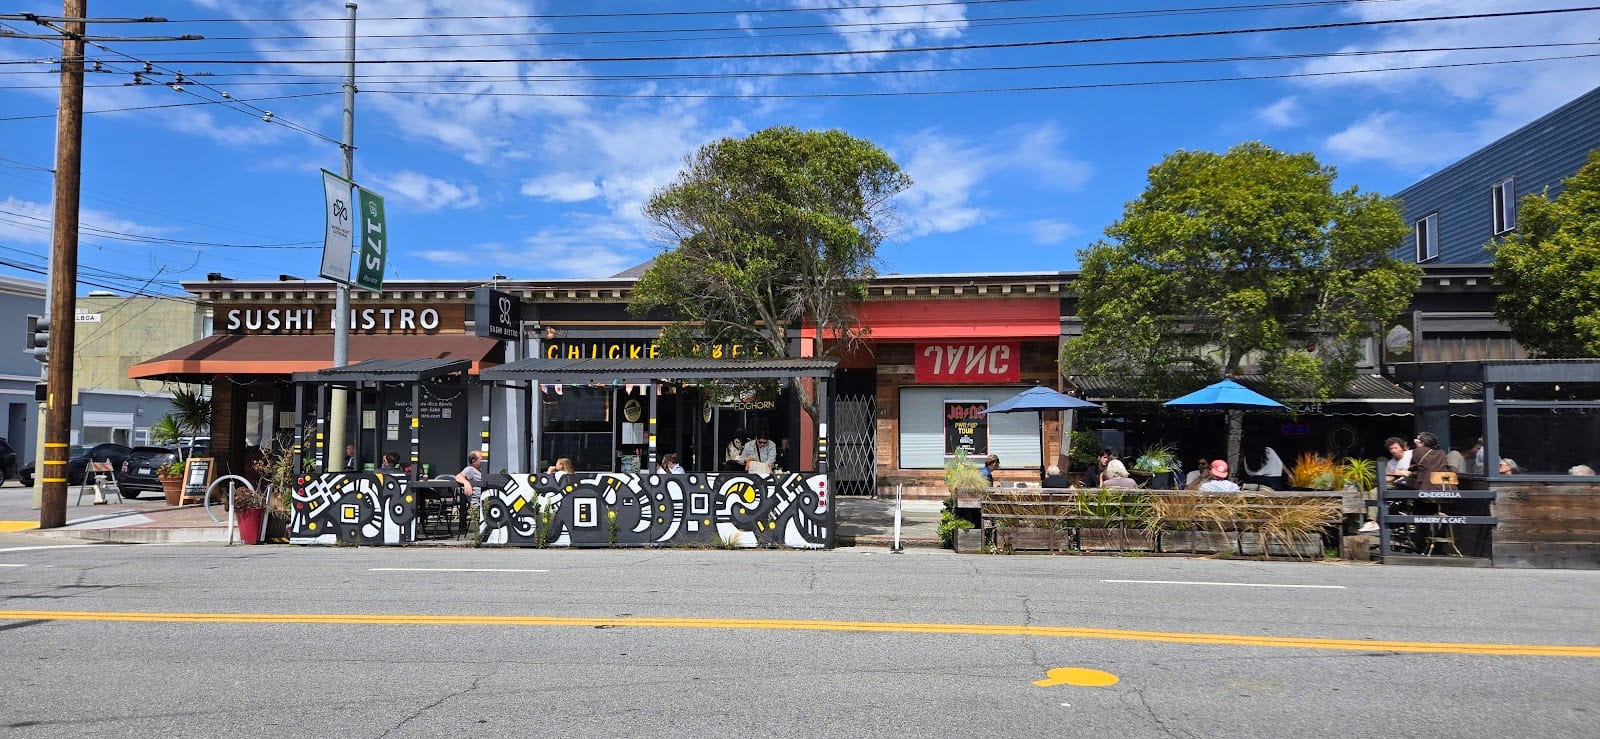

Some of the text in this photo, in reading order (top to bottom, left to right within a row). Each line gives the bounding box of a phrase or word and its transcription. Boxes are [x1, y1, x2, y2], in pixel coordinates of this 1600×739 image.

[366, 218, 382, 271] 175
[227, 308, 313, 331] SUSHI
[547, 342, 670, 360] CHICKE
[734, 400, 775, 410] FOGHORN
[1296, 402, 1323, 413] CAFÉ
